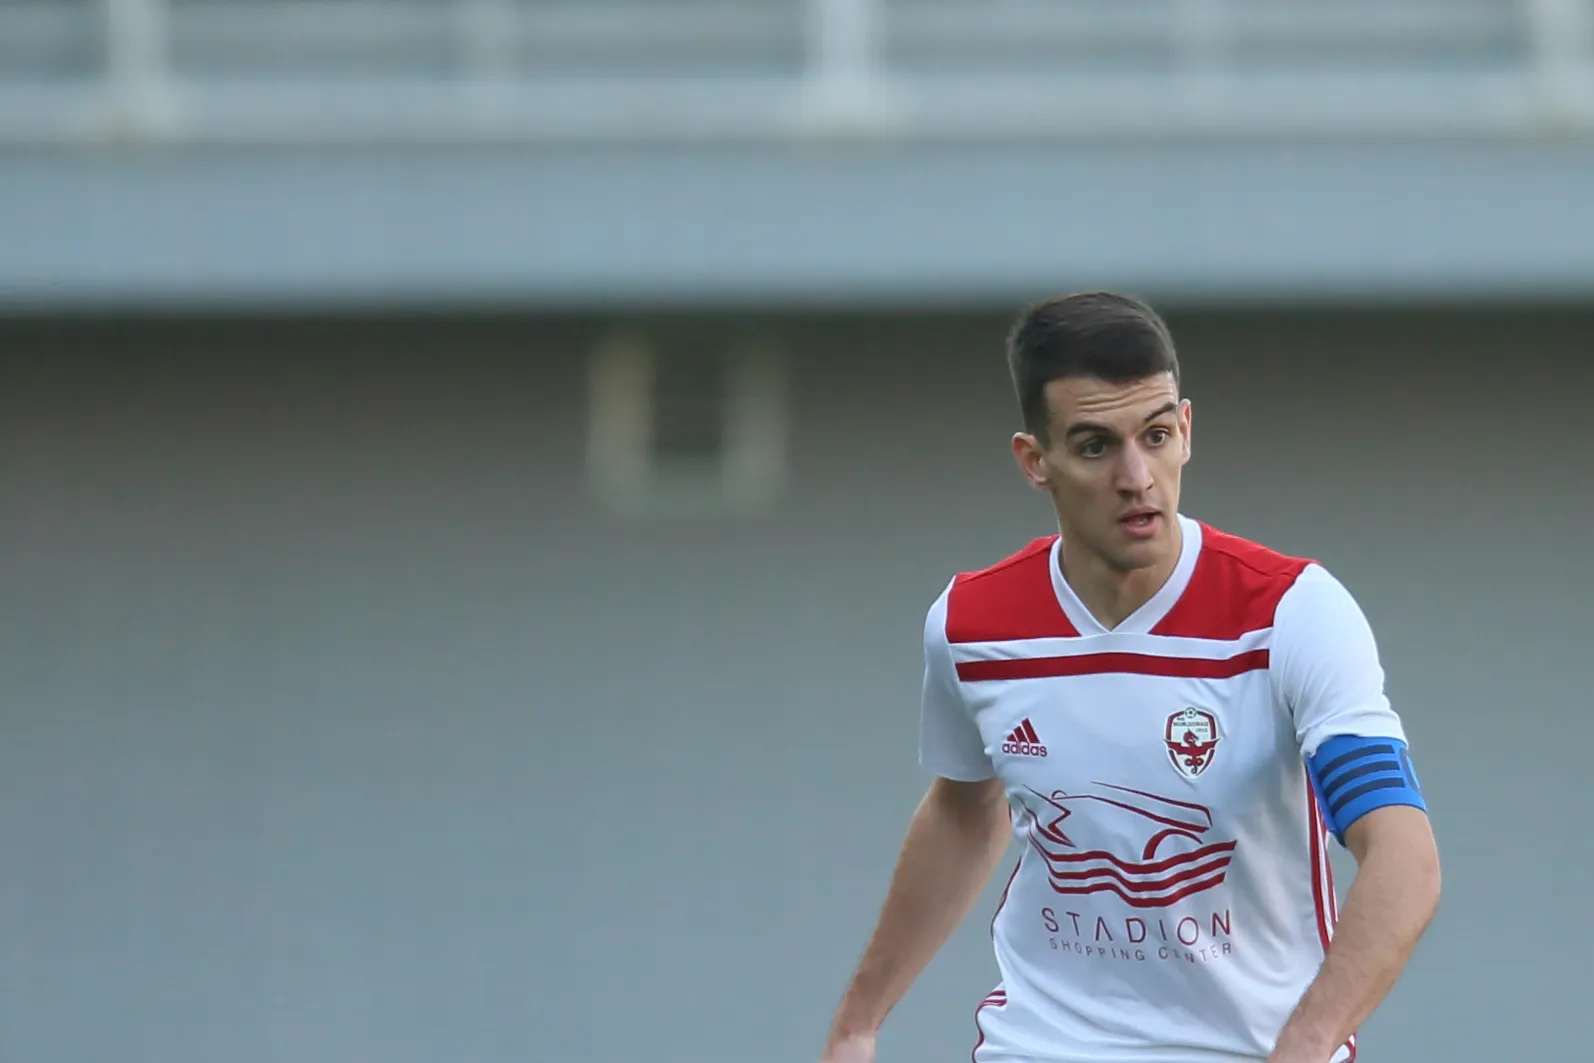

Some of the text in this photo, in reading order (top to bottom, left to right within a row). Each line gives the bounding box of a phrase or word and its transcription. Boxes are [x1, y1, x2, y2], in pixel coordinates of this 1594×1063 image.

[1002, 741, 1047, 757] adidas
[1042, 907, 1231, 945] STADION
[1049, 937, 1146, 961] SHOPPING
